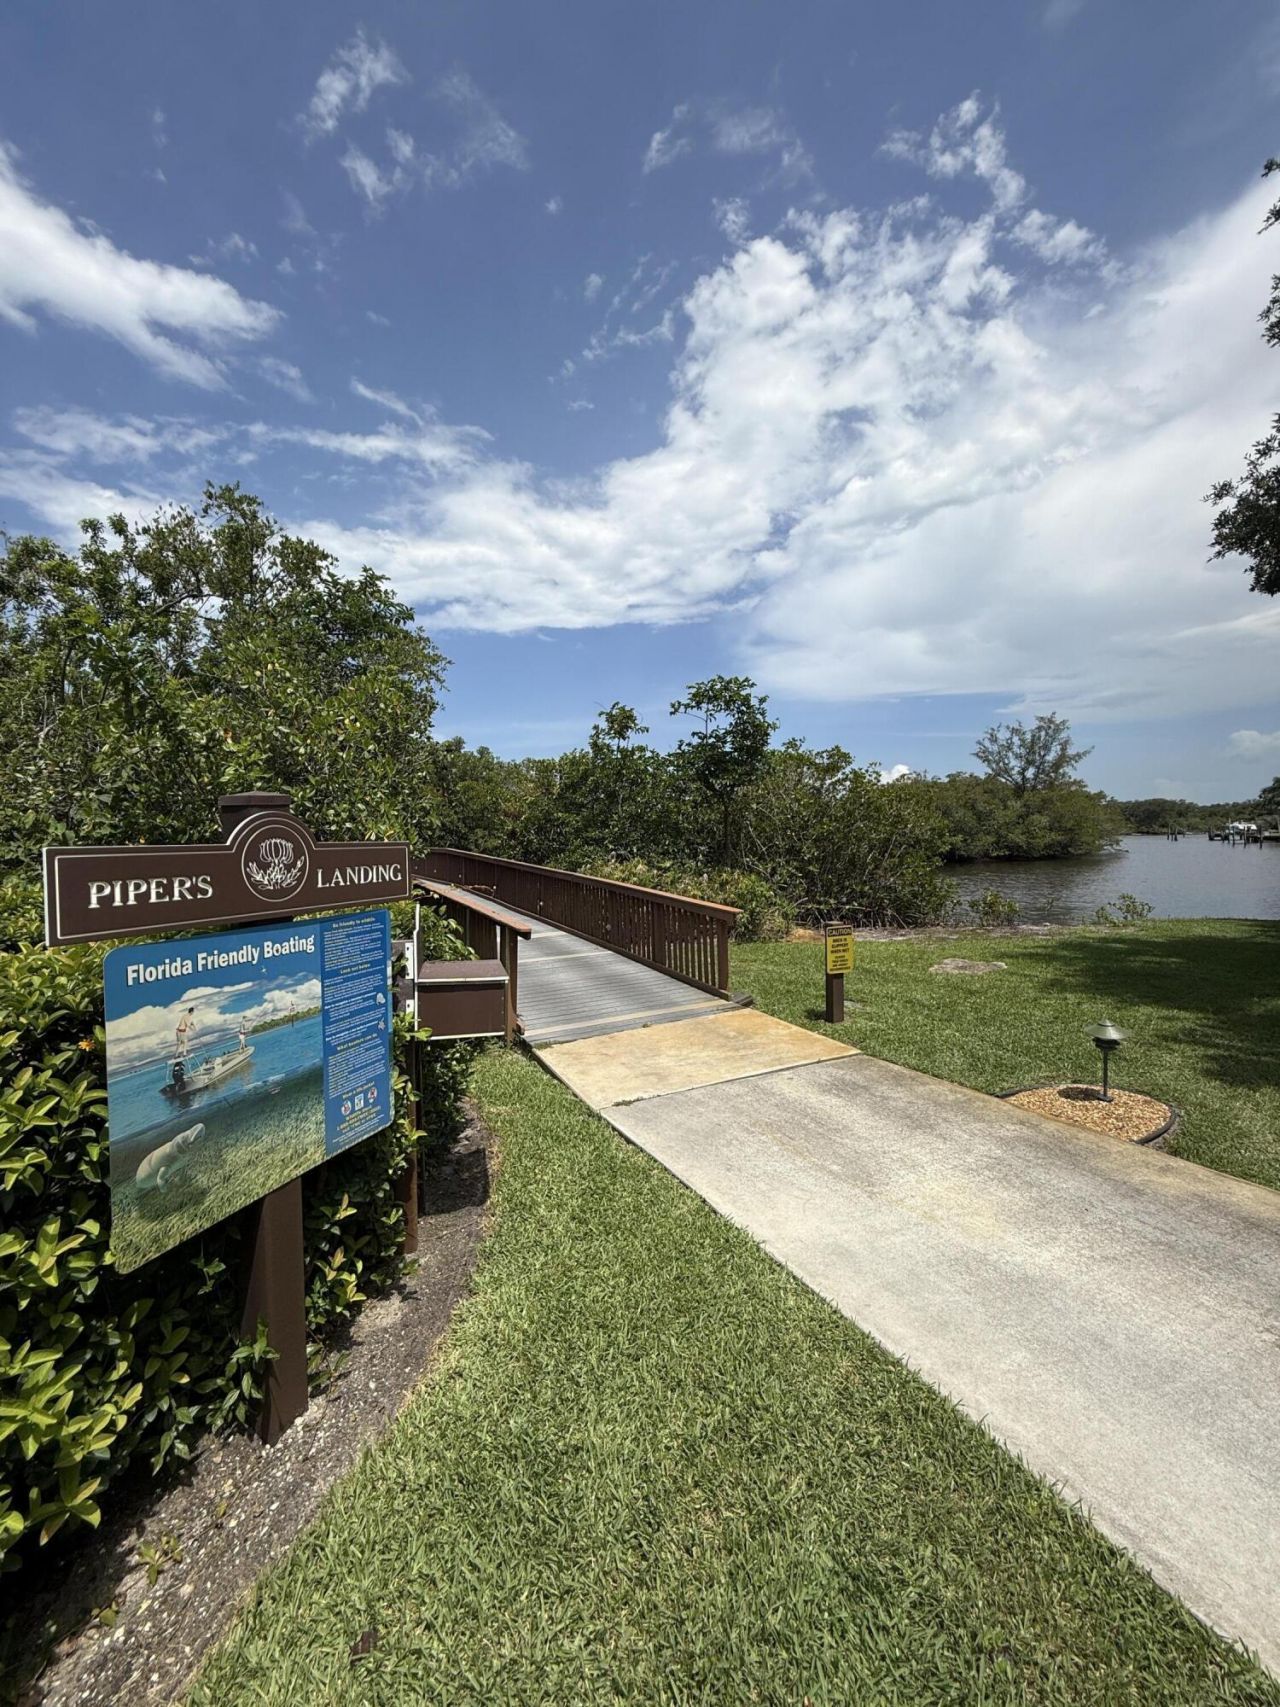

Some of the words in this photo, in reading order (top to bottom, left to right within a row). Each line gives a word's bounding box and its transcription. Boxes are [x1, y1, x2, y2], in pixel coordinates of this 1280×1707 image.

[87, 875, 214, 909] PIPER'S
[316, 863, 402, 888] LANDING
[828, 927, 851, 936] CAUTION
[126, 956, 193, 986] Florida
[197, 944, 260, 972] Friendly
[263, 933, 315, 958] Boating
